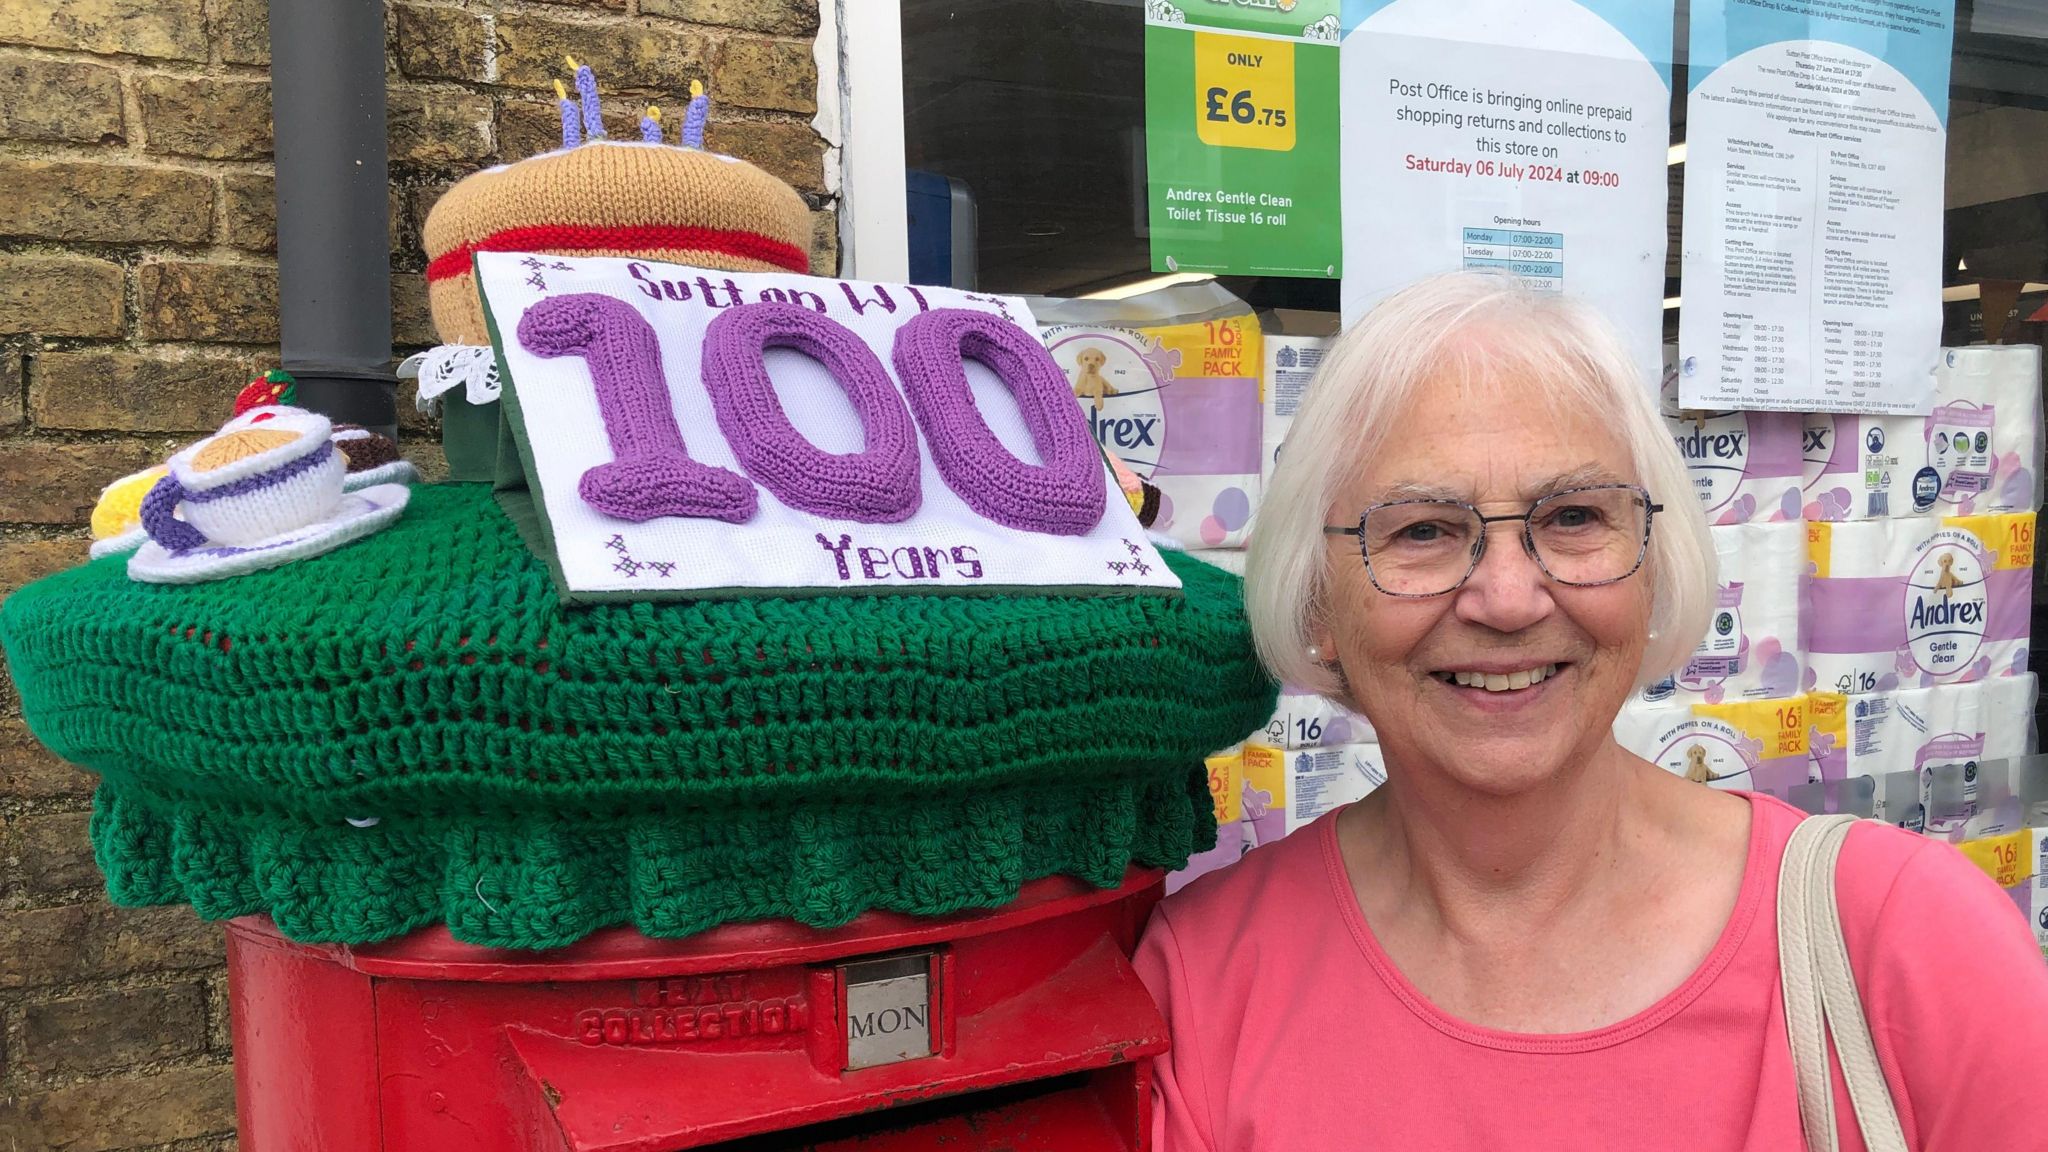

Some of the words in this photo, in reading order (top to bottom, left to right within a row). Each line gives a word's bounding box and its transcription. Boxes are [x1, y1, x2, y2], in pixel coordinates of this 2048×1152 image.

[1228, 52, 1263, 67] ONLY
[1796, 61, 1815, 70] Thursday
[1833, 66, 1844, 74] 2024
[1731, 86, 1748, 96] During
[1795, 82, 1815, 91] Saturday
[1822, 85, 1830, 93] July
[1831, 86, 1842, 94] 2024
[1206, 86, 1286, 127] £6.75
[1390, 79, 1422, 97] Post
[1427, 83, 1468, 102] Office
[1472, 88, 1483, 103] is
[1488, 90, 1542, 113] bringing
[1546, 98, 1583, 115] online
[1587, 105, 1632, 122] prepaid
[1397, 105, 1462, 129] shopping
[1468, 114, 1515, 130] returns
[1519, 119, 1542, 133] and
[1547, 121, 1611, 141] collections
[1615, 129, 1626, 143] to
[1788, 128, 1815, 137] Alternative
[1816, 130, 1827, 138] Post
[1829, 132, 1842, 140] Office
[1844, 134, 1861, 142] services
[1476, 137, 1501, 153] this
[1505, 141, 1538, 156] store
[1542, 147, 1558, 158] on
[1406, 154, 1472, 177] Saturday
[1476, 160, 1494, 176] 06
[1498, 162, 1524, 181] July
[1528, 164, 1562, 182] 2024
[1567, 170, 1579, 183] at
[1583, 170, 1619, 187] 09:00
[1166, 188, 1212, 202] Andrex
[1216, 190, 1256, 204] Gentle
[1260, 194, 1292, 207] Clean
[1166, 207, 1201, 221] Toilet
[1206, 209, 1246, 223] Tissue
[1250, 212, 1263, 224] 16
[1267, 214, 1286, 226] roll
[1494, 215, 1521, 226] Opening
[1523, 218, 1541, 226] hours
[1467, 233, 1492, 242] Monday
[1513, 235, 1553, 245] 07:00-22:00
[1467, 247, 1493, 257] Tuesday
[1513, 249, 1552, 259] 07:00-22:00
[1512, 264, 1552, 274] 07:00-22:00
[627, 262, 827, 314] Sutton
[1128, 329, 1148, 347] ROLL
[1203, 320, 1235, 346] 16
[1204, 348, 1242, 359] FAMILY
[1203, 361, 1242, 376] PACK
[517, 293, 1106, 536] 100
[2010, 522, 2030, 542] 16
[1916, 539, 1930, 552] WITH
[1966, 537, 1978, 550] ROLL
[815, 533, 983, 580] Years
[2011, 554, 2031, 565] PACK
[1910, 594, 1983, 629] Andrex
[1930, 641, 1957, 652] Gentle
[1932, 654, 1954, 663] Clean
[1859, 672, 1876, 691] 16
[1776, 707, 1797, 729] 16
[1296, 718, 1321, 741] 16
[1659, 728, 1676, 743] WITH
[1720, 726, 1736, 739] ROLL
[1778, 730, 1801, 740] FAMILY
[1778, 741, 1801, 753] PACK
[1248, 760, 1272, 768] PACK
[1994, 844, 2013, 864] 16
[850, 1004, 927, 1039] MON
